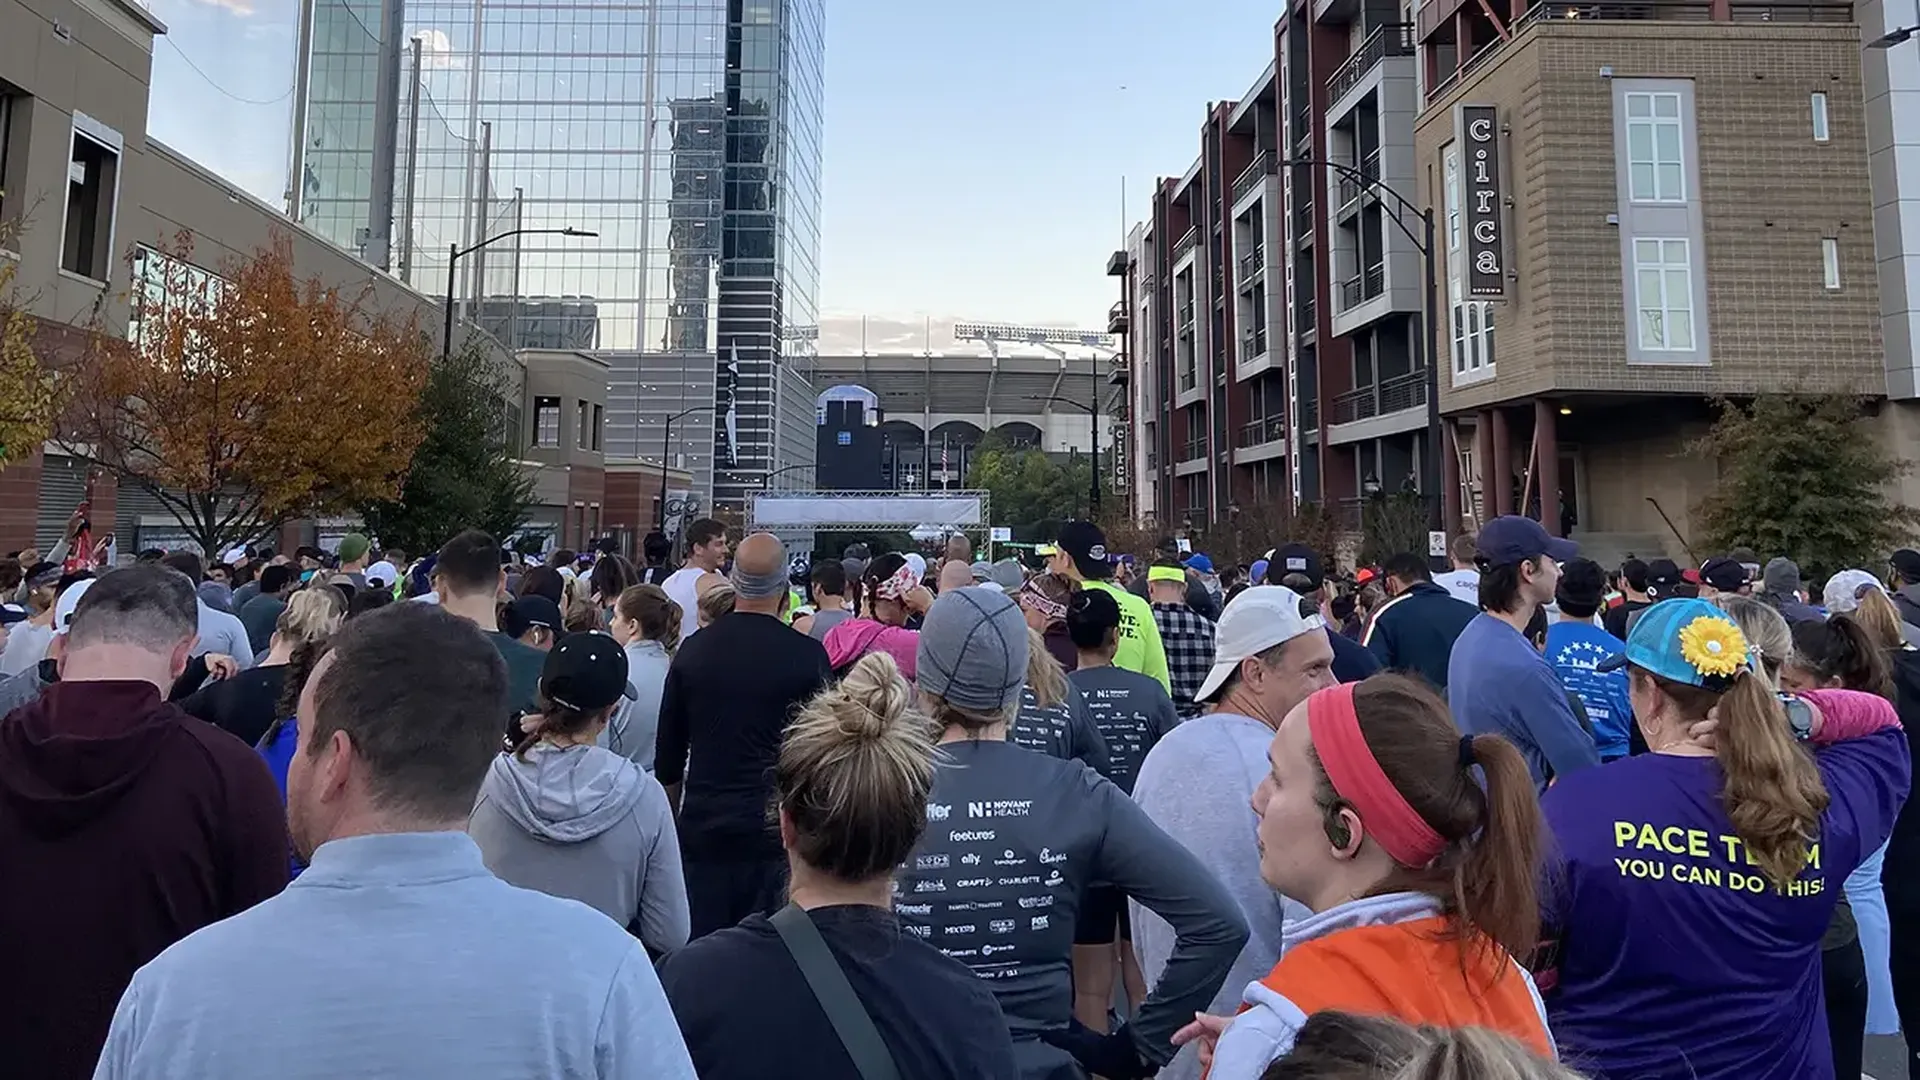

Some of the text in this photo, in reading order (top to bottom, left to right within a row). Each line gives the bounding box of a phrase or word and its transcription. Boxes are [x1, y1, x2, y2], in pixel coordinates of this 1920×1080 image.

[993, 801, 1033, 809] NOVANT
[994, 808, 1029, 817] HEALTH
[1614, 820, 1821, 870] PACE TM
[961, 853, 981, 866] ally
[1614, 857, 1826, 898] YOU CAN DO HIS!
[957, 879, 985, 888] CRAFT
[1031, 915, 1049, 926] FOX
